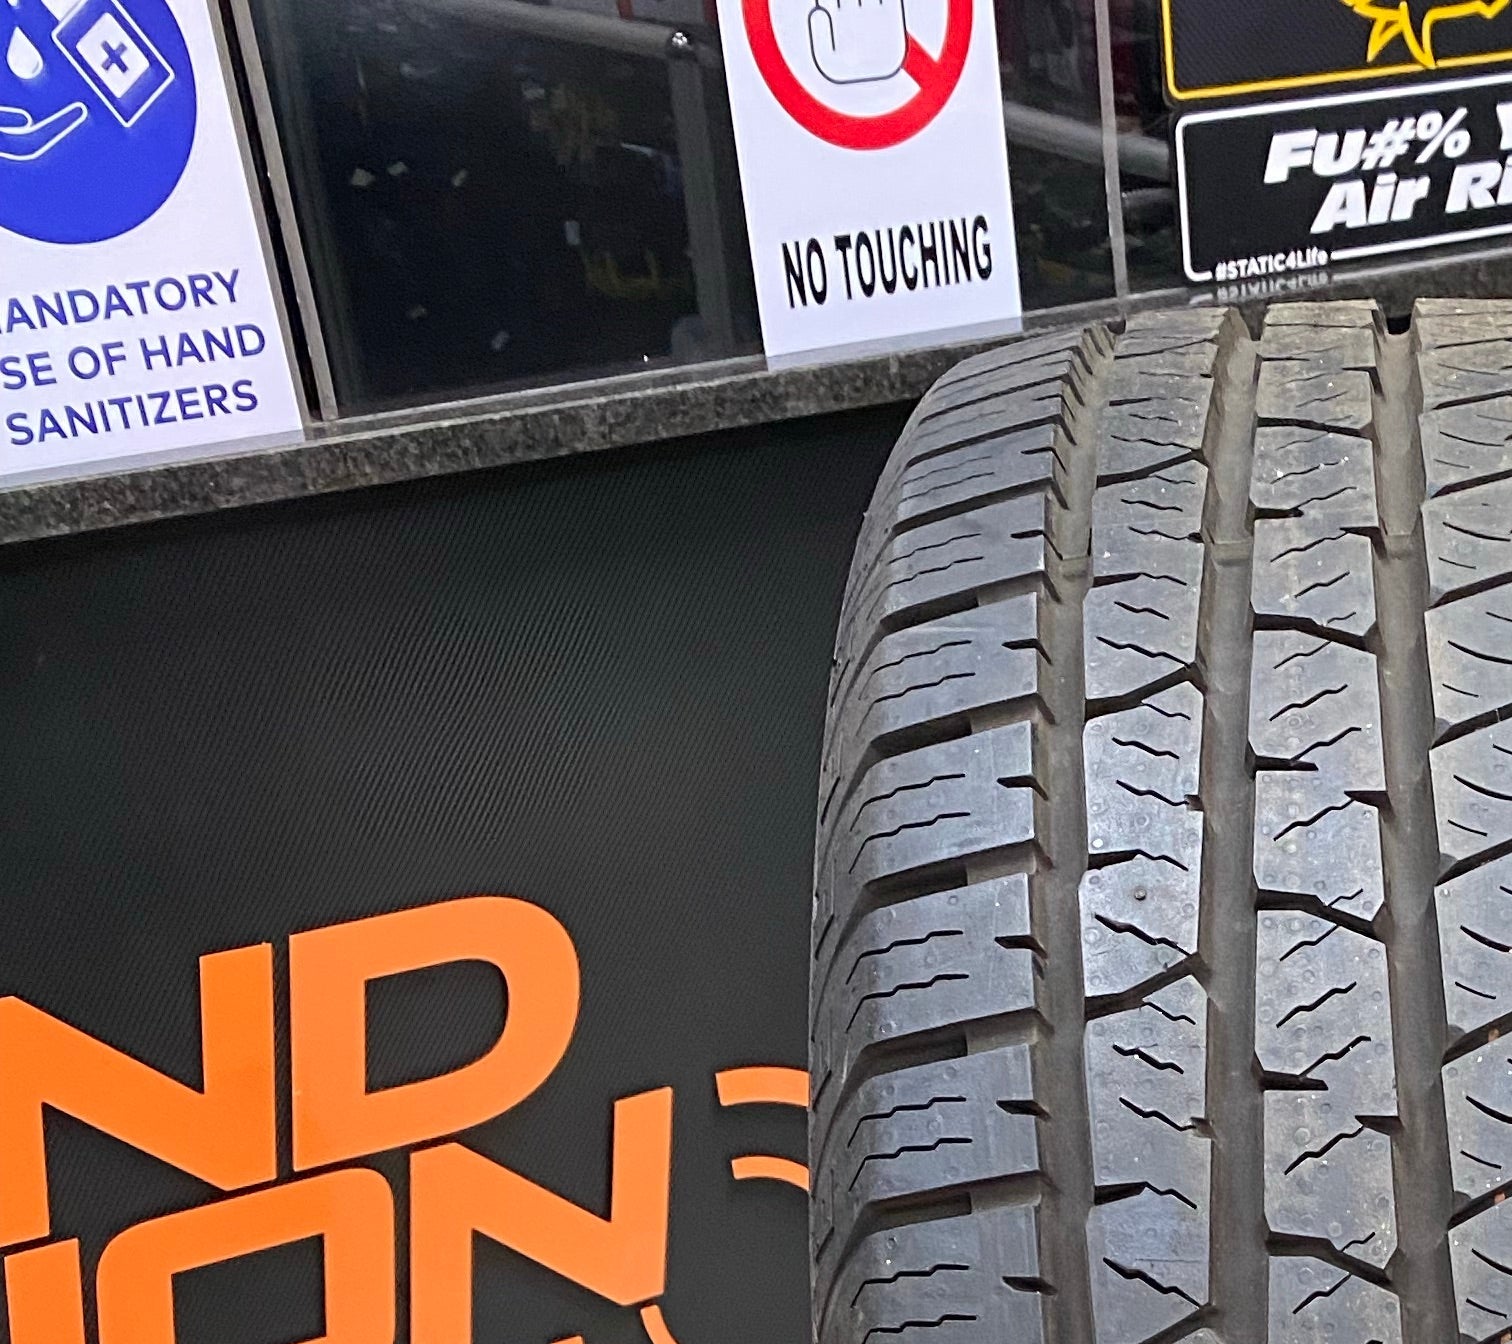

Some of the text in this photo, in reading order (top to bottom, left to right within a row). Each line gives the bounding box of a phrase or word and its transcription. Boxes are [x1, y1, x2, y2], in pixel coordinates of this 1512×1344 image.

[1310, 172, 1431, 235] Air
[781, 215, 992, 309] NO TOUCHING
[0, 268, 240, 335] ANDATORY
[68, 341, 126, 380] OF
[139, 323, 265, 371] HAND
[6, 379, 258, 446] SANITIZERS
